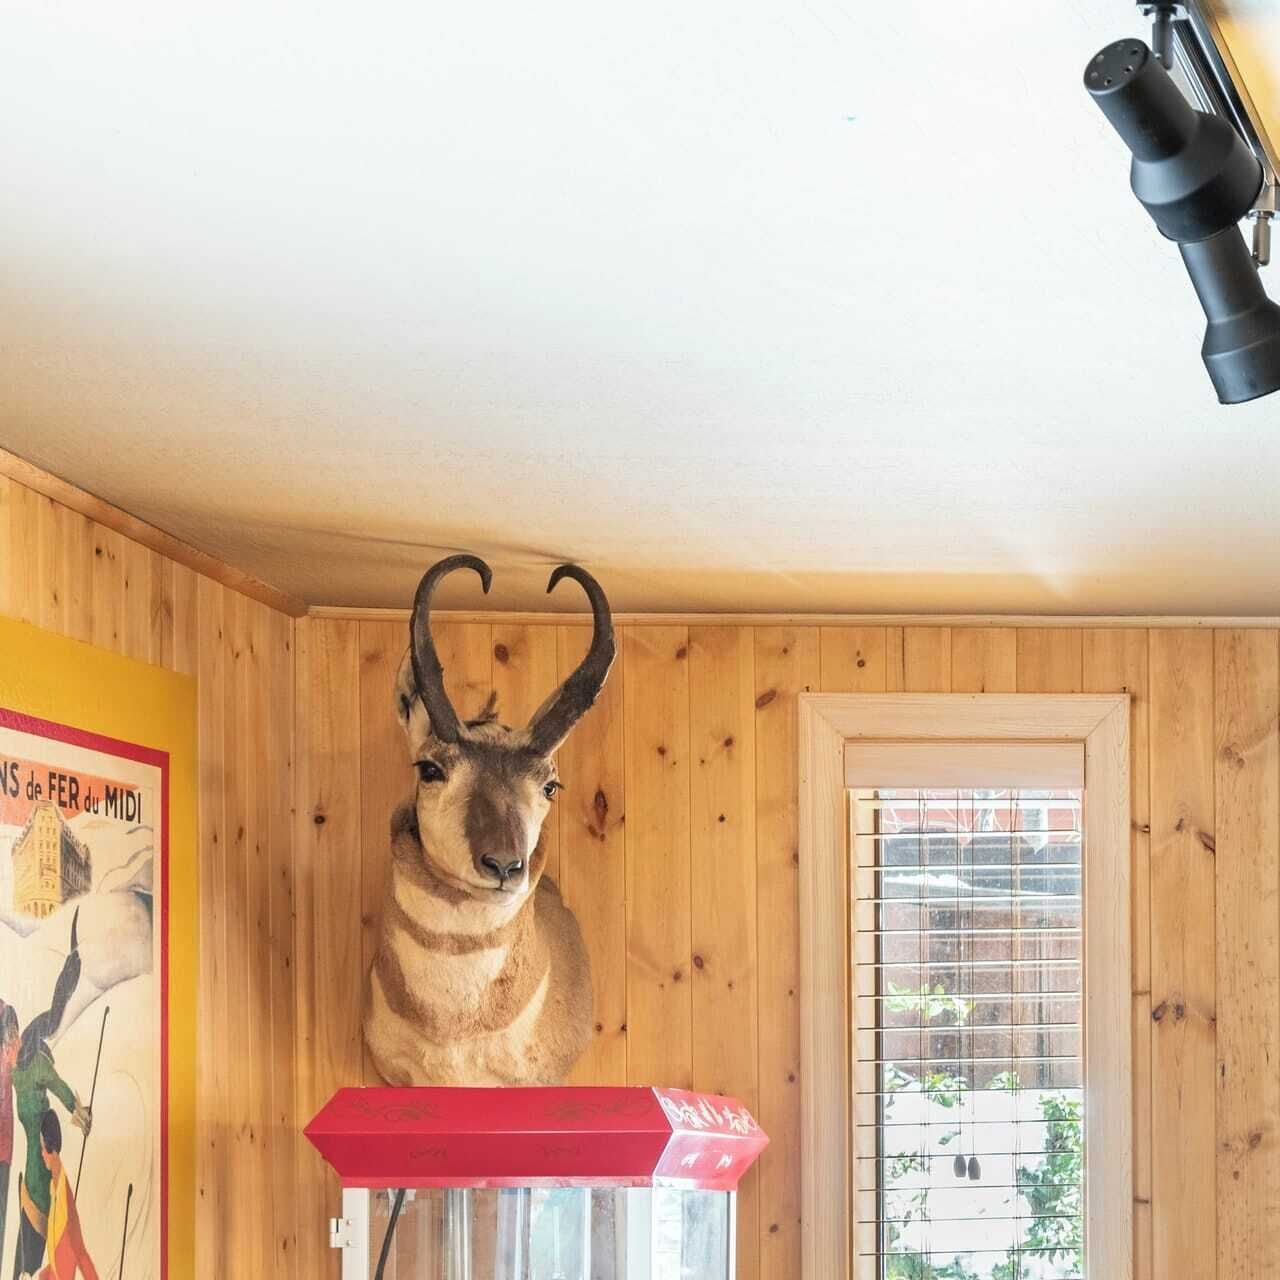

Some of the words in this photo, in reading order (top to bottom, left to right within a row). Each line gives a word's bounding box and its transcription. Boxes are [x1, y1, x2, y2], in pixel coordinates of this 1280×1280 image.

[26, 770, 42, 801] de
[48, 771, 80, 810] FER
[84, 786, 99, 815] du
[105, 784, 141, 824] MIDI
